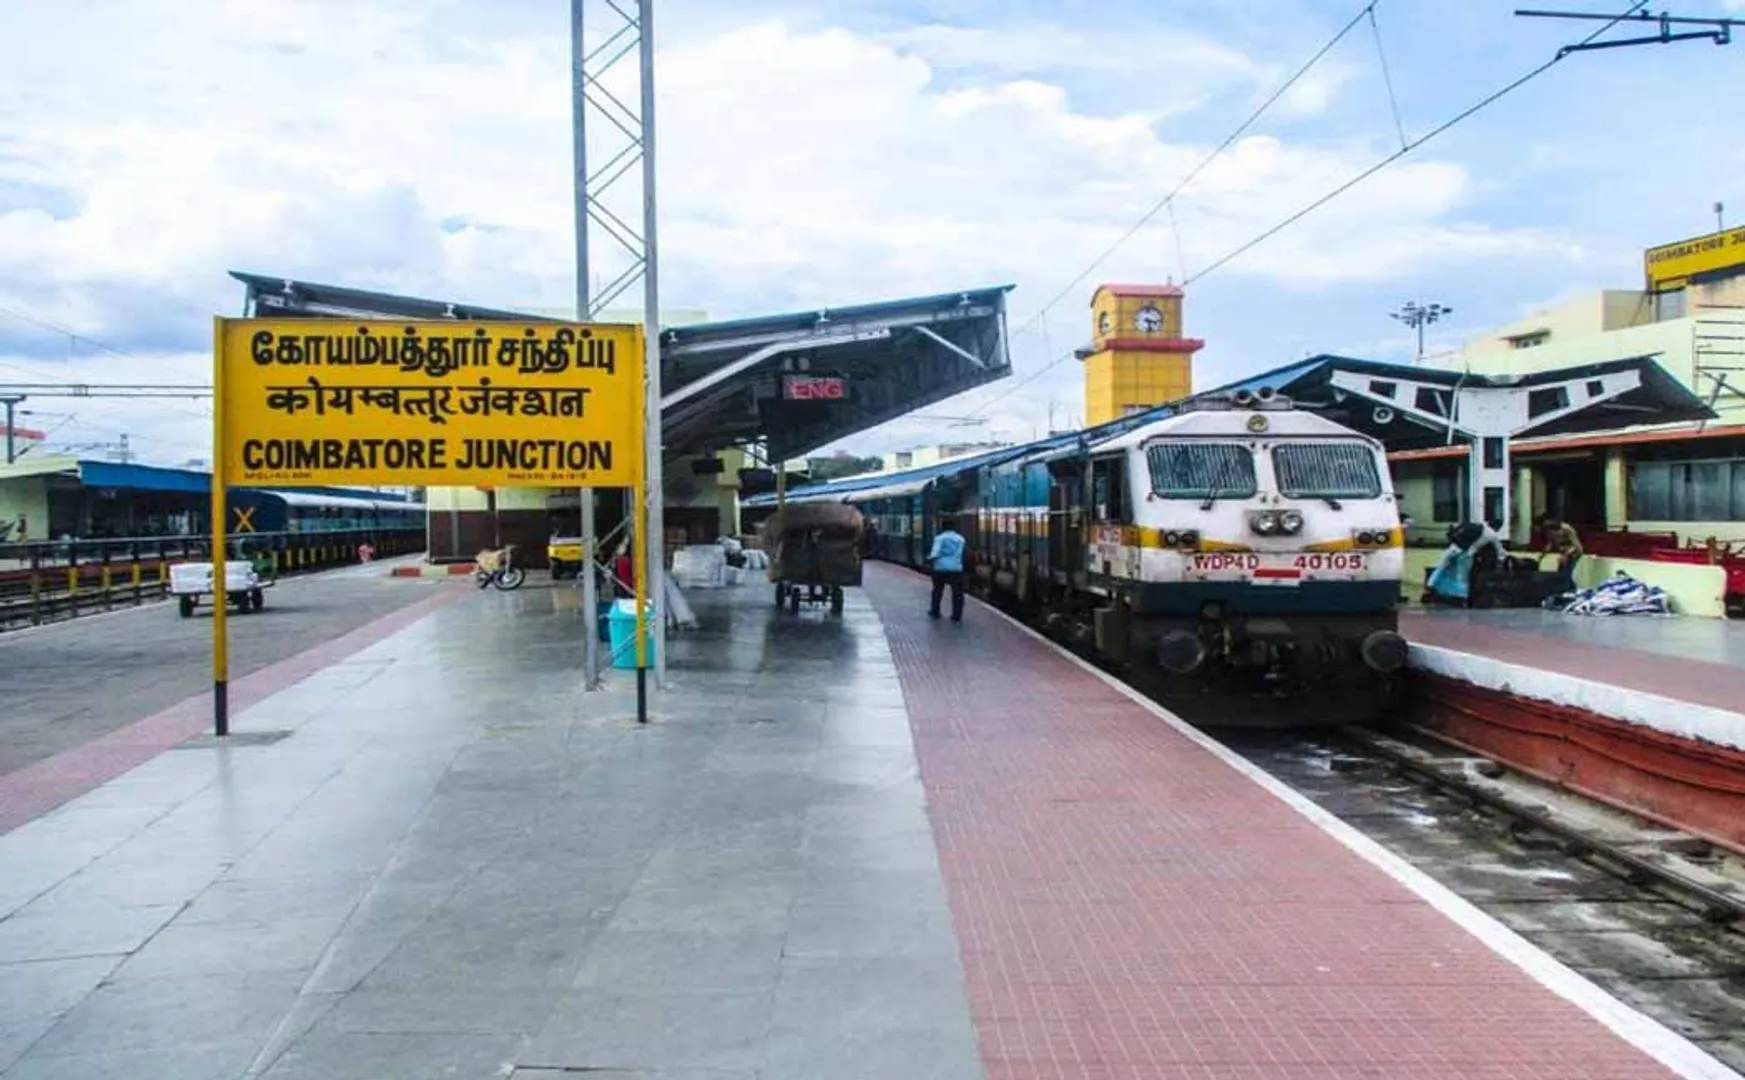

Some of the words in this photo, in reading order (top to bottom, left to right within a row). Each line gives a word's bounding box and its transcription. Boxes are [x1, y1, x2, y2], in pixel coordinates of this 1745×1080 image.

[252, 326, 492, 377] கோயம்பத்தூர்
[497, 328, 615, 374] சந்திப்பு
[266, 376, 455, 424] कोयम्बत्तूर
[457, 376, 591, 417] जंक्शन
[793, 381, 844, 399] ENG
[243, 439, 446, 470] COIMBATORE
[455, 440, 612, 470] JUNCTION
[1194, 555, 1260, 570] WDP4D
